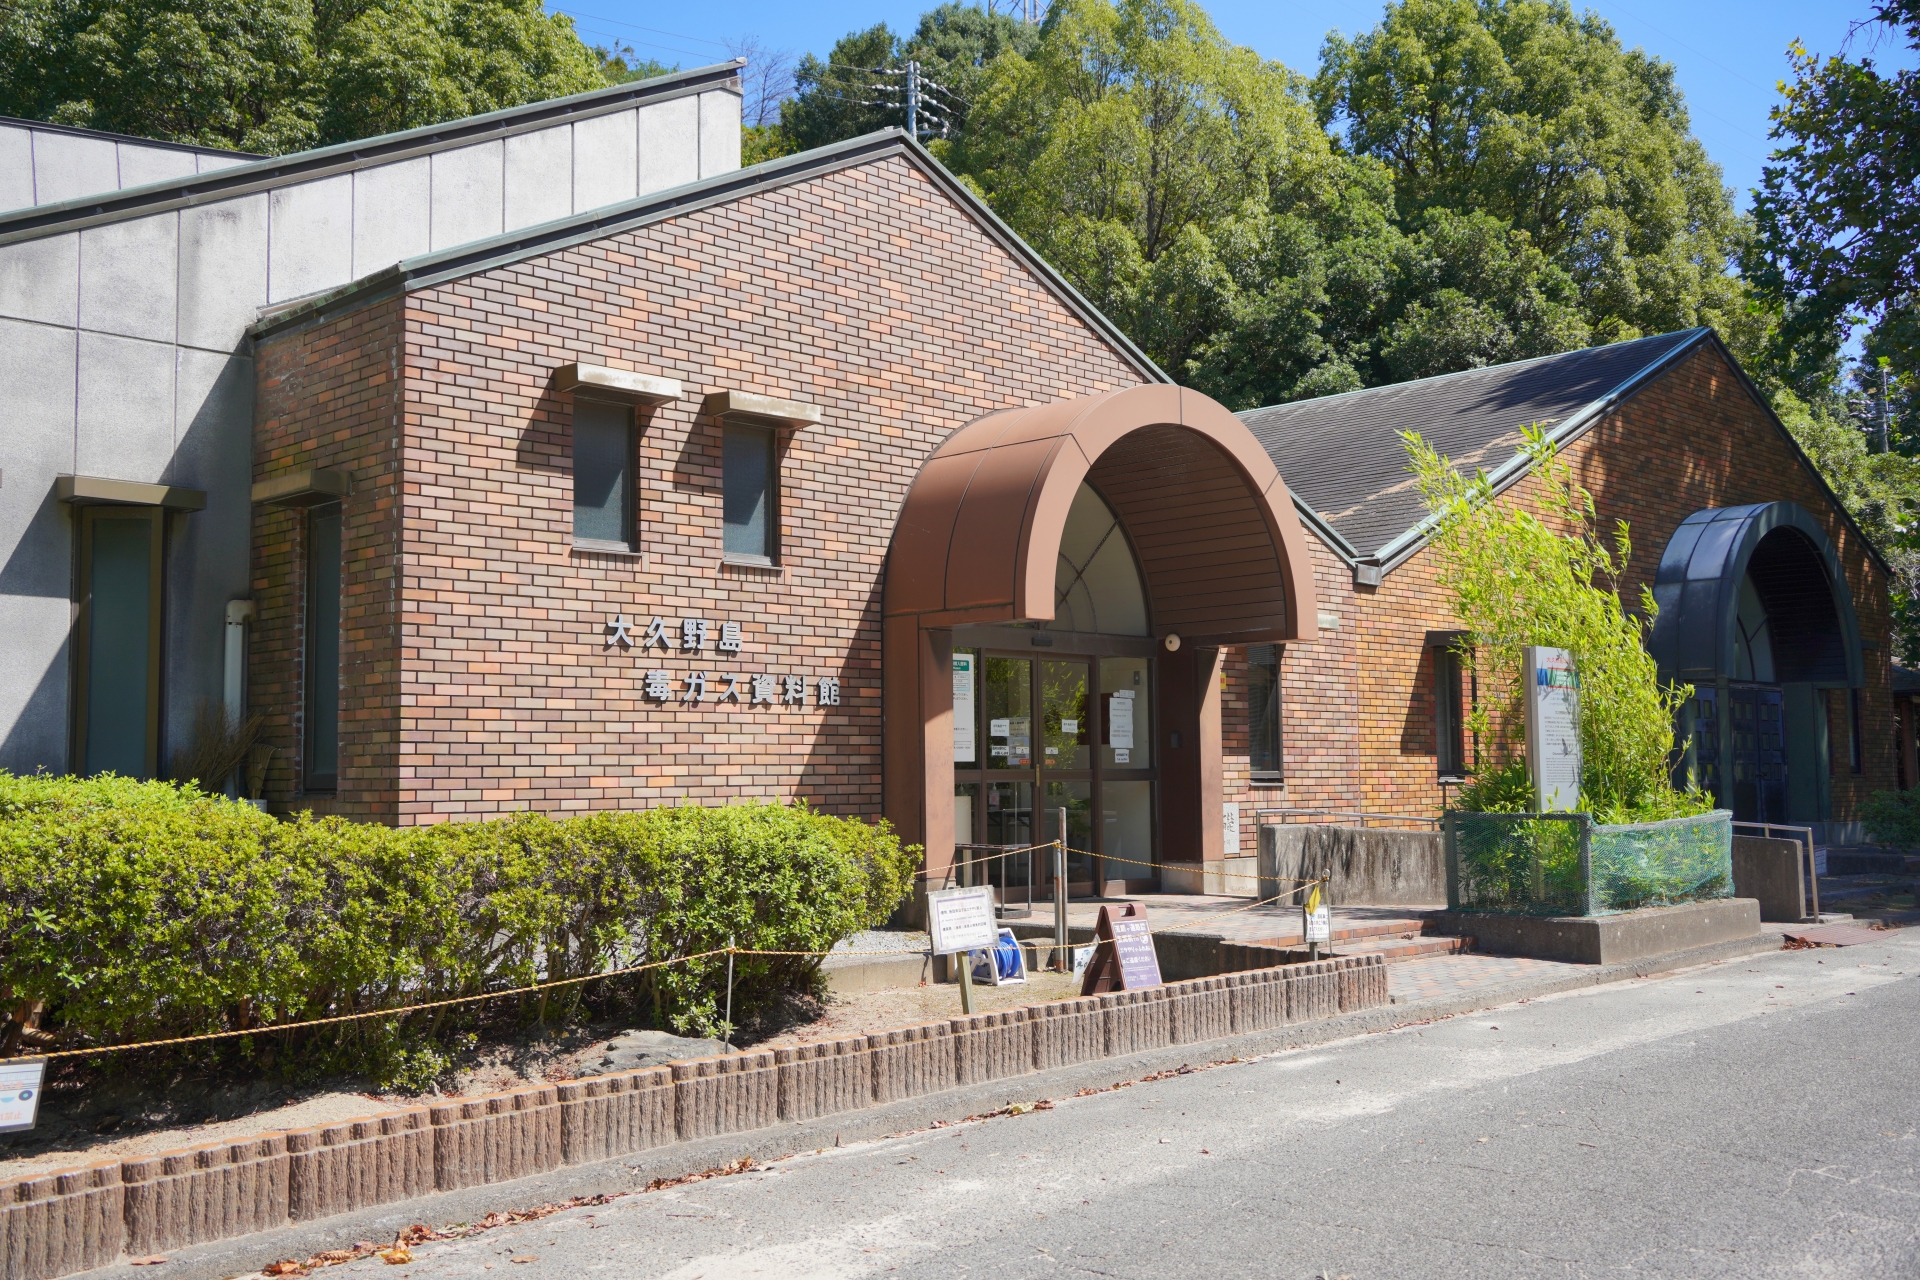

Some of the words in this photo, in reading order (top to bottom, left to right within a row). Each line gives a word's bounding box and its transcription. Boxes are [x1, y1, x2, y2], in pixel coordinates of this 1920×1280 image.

[607, 614, 743, 652] 大久野島
[645, 669, 841, 706] 毒ガス資料館
